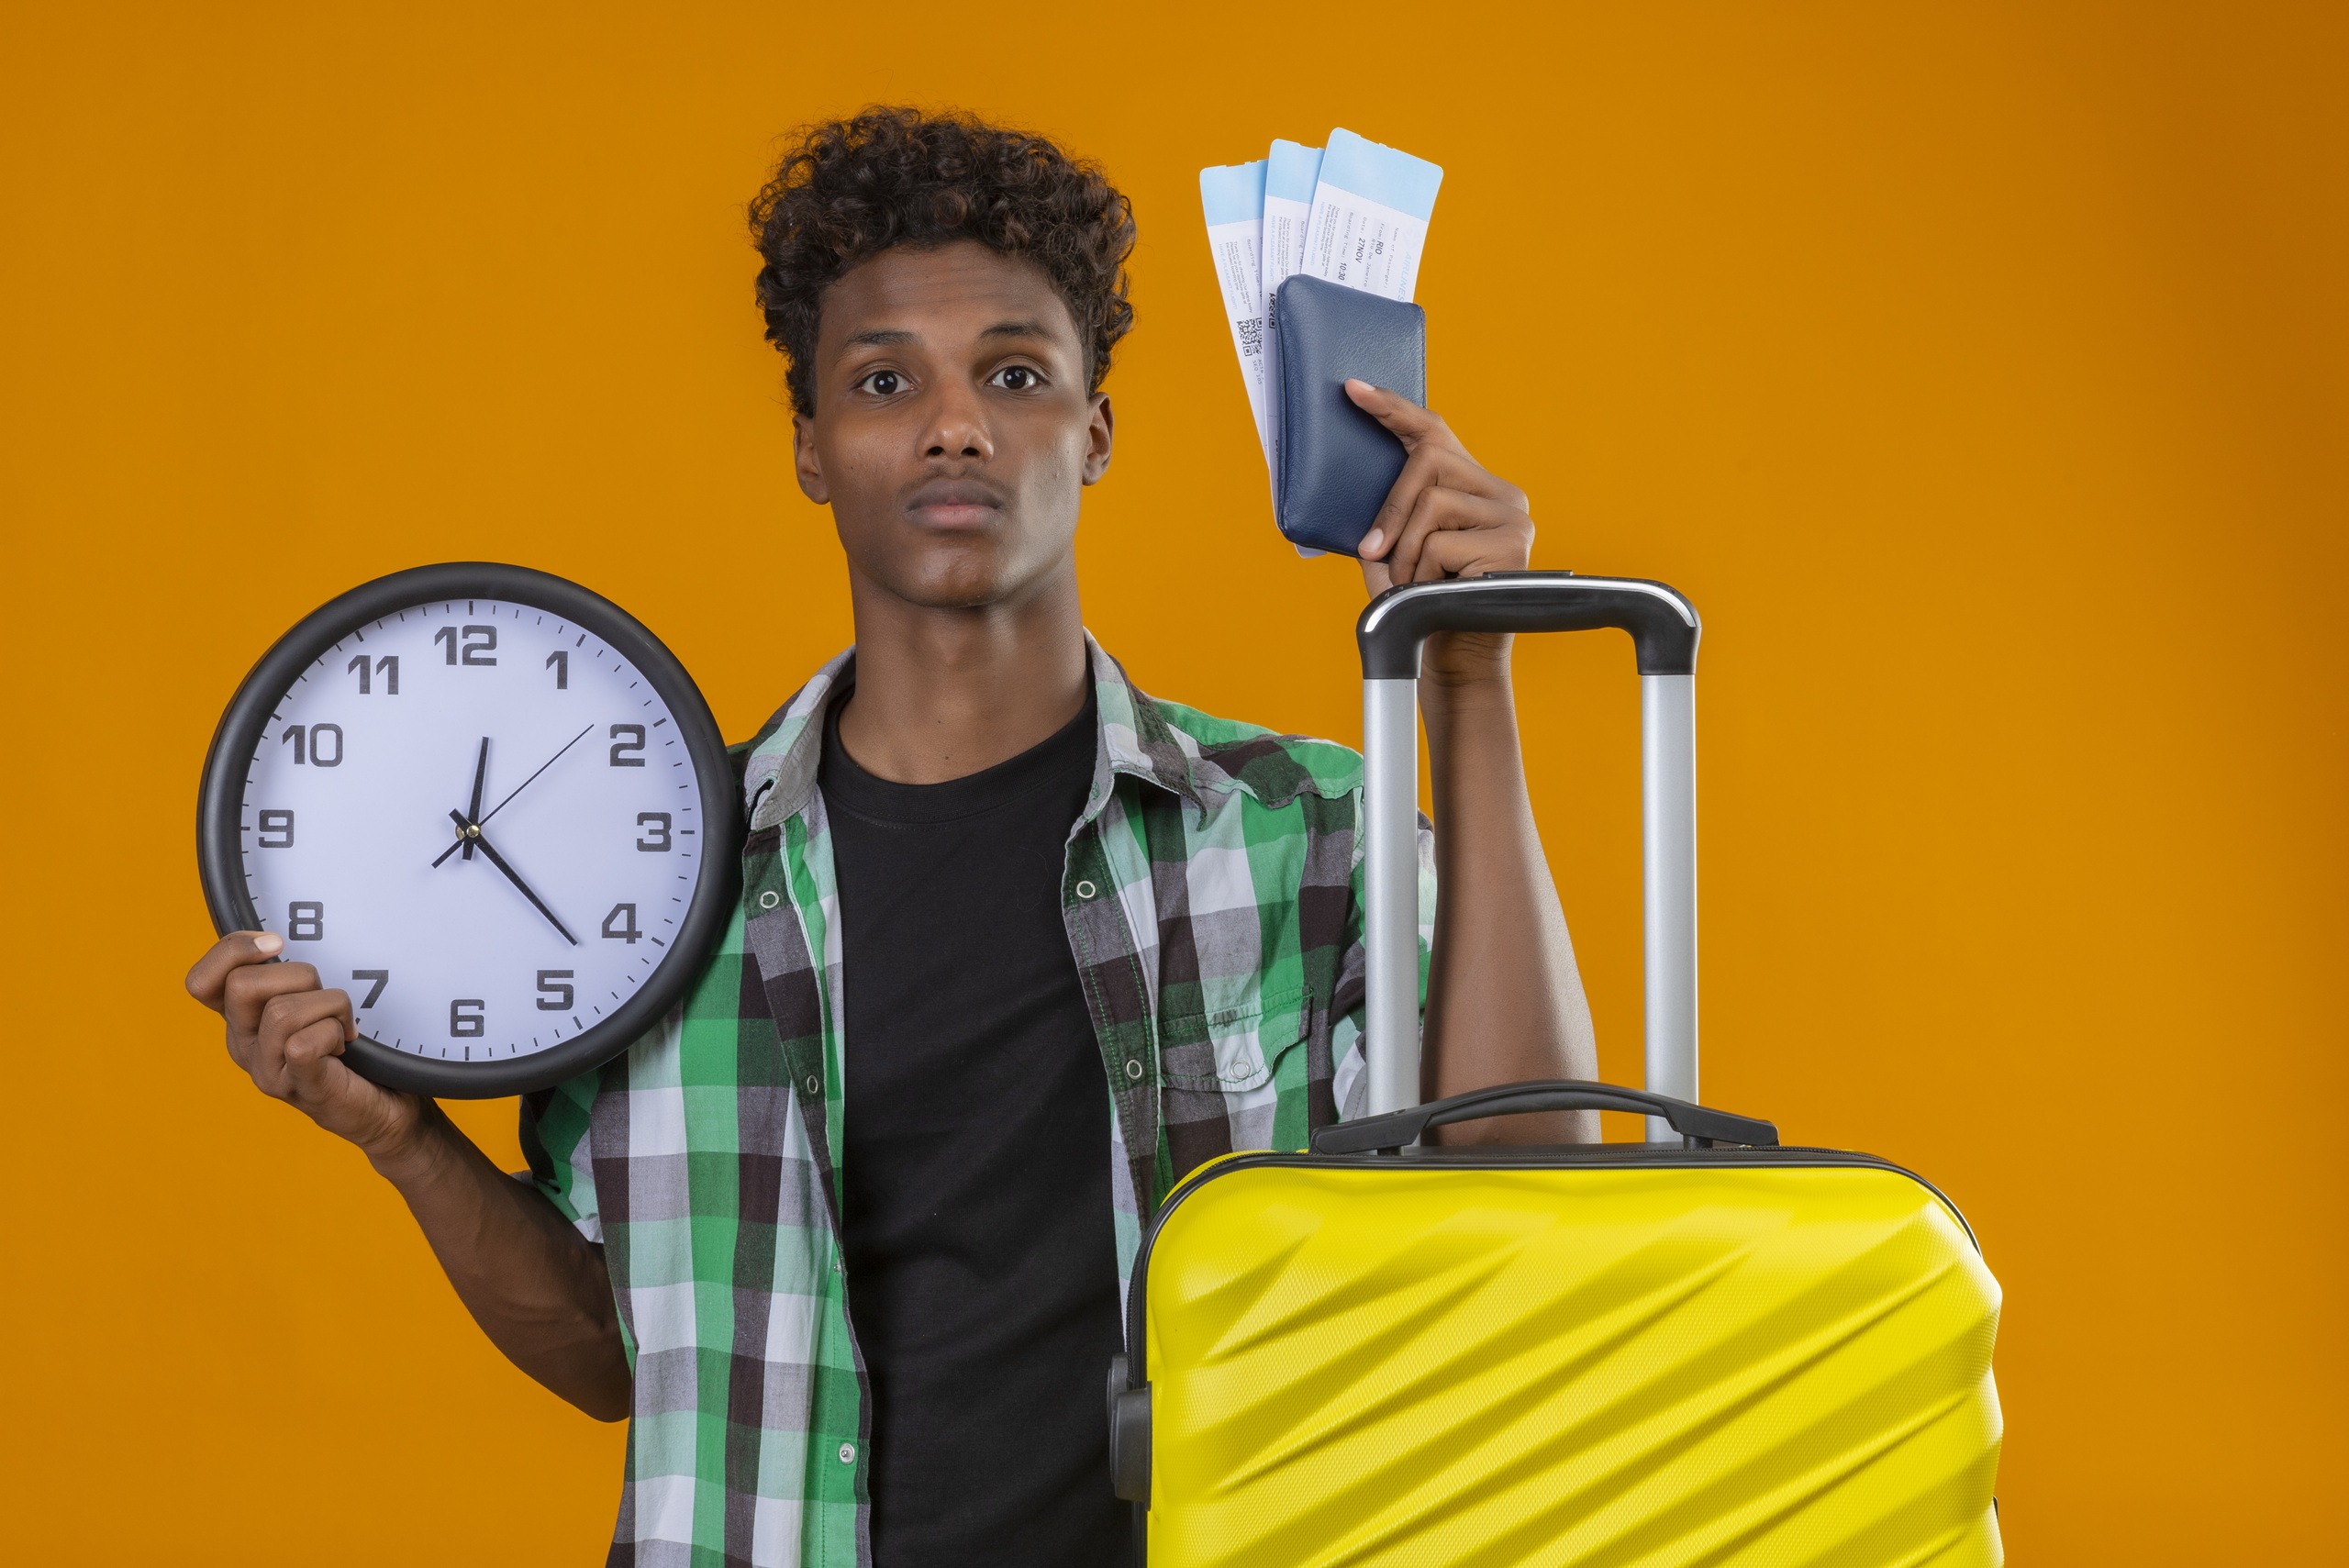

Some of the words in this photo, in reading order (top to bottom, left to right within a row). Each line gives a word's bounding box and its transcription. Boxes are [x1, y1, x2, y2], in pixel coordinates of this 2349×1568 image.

[1342, 210, 1354, 239] Boarding
[1359, 216, 1367, 234] Date:
[1353, 237, 1366, 263] 27NOV
[1337, 261, 1347, 281] 10:30
[1396, 250, 1412, 301] AIRLINES
[434, 625, 497, 666] 12
[348, 654, 399, 695] 11
[545, 651, 568, 690] 1
[282, 723, 343, 767] 10
[609, 723, 646, 767] 2
[258, 809, 295, 849] 9
[636, 812, 672, 852] 3
[288, 901, 324, 941] 8
[601, 903, 642, 944] 4
[351, 969, 389, 1009] 7
[536, 969, 574, 1011] 5
[450, 998, 484, 1038] 6
